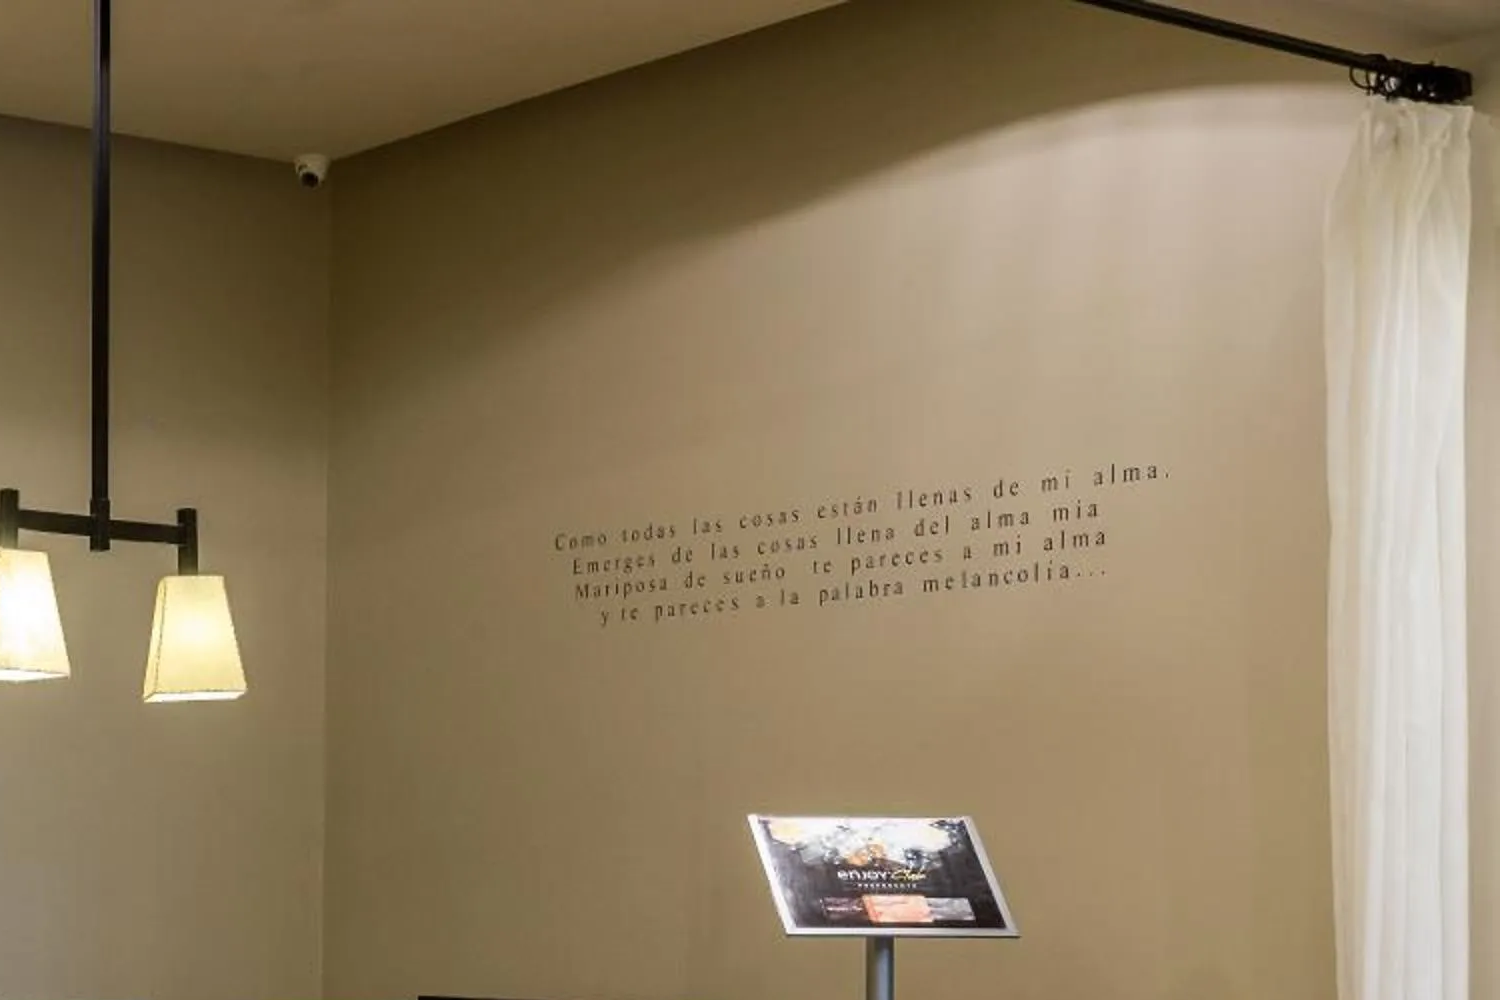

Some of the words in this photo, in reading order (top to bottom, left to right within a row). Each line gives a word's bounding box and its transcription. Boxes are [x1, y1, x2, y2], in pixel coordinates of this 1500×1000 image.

[555, 533, 607, 551] Como
[622, 523, 676, 543] todas
[693, 518, 722, 535] las
[740, 510, 799, 528] cosas
[817, 496, 877, 519] están
[897, 486, 972, 510] llenas
[993, 480, 1018, 499] de
[1042, 470, 1070, 492] mi
[573, 554, 656, 576] Emerges
[672, 546, 692, 564] de
[711, 542, 739, 560] las
[757, 536, 817, 555] cosas
[838, 526, 894, 544] llena
[914, 515, 948, 536] del
[971, 510, 1029, 531] alma
[576, 577, 667, 600] Mariposa
[684, 571, 706, 589] de
[724, 563, 785, 584] sueño
[813, 560, 831, 574] te
[851, 549, 943, 574] pareces
[964, 546, 972, 560] a
[994, 535, 1021, 556] mi
[1044, 530, 1104, 551] alma
[601, 609, 610, 628] y
[621, 605, 638, 621] te
[655, 597, 739, 622] pareces
[756, 594, 765, 608] a
[780, 588, 800, 606] la
[820, 580, 903, 606] palabra
